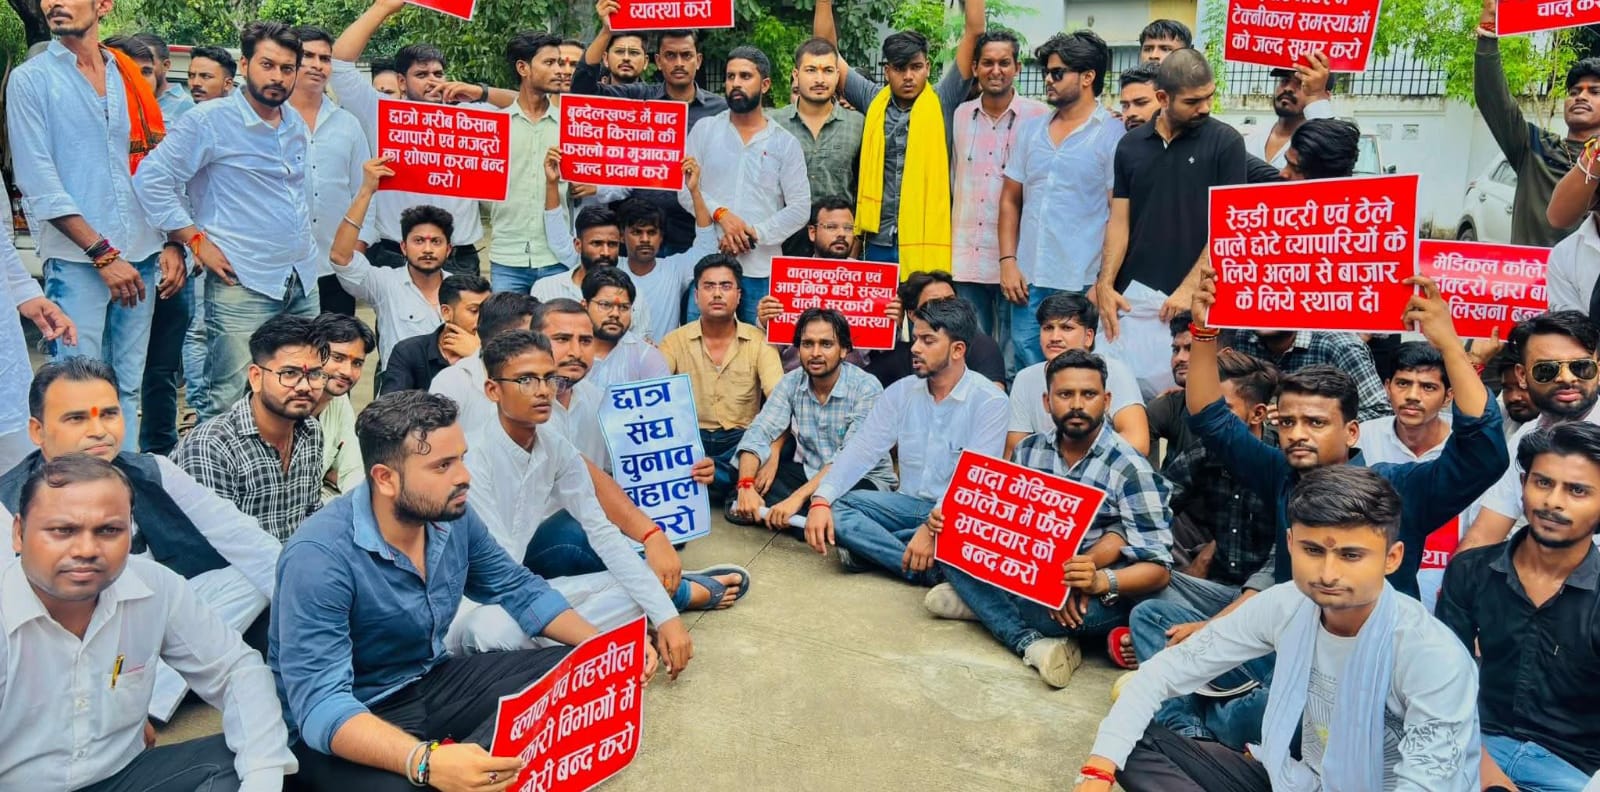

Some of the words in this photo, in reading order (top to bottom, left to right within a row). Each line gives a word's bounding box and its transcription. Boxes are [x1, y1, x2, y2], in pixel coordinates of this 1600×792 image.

[630, 2, 681, 20] व्यवस्था
[1232, 4, 1296, 30] टेक्नीकल
[1297, 10, 1371, 33] समस्याओं
[1232, 30, 1250, 50] को
[1252, 36, 1284, 55] जल्द
[1330, 38, 1362, 59] करो
[389, 107, 418, 125] छात्रो
[422, 110, 453, 129] गरीब
[389, 128, 434, 146] व्यापारी
[439, 130, 454, 148] एवं
[458, 136, 500, 156] मजदूरो
[607, 124, 654, 142] किसानो
[658, 128, 676, 143] की
[382, 148, 400, 162] का
[404, 146, 441, 167] शोषण
[444, 154, 478, 170] करना
[481, 158, 506, 173] बन्द
[562, 142, 603, 158] फसलो
[606, 146, 625, 159] का
[627, 147, 680, 162] मुआवजा
[572, 162, 602, 176] जल्द
[605, 164, 640, 178] प्रदान
[642, 164, 669, 180] करो
[1324, 197, 1350, 225] एवं
[1354, 196, 1394, 224] ठेले
[1214, 232, 1246, 256] वाले
[1250, 230, 1281, 256] छोटे
[1285, 226, 1380, 254] व्यापारियों
[1383, 225, 1408, 252] के
[787, 266, 862, 283] वातानुकूलित
[866, 270, 882, 284] एवं
[1221, 258, 1258, 284] लिये
[1263, 262, 1310, 284] अलग
[1315, 258, 1334, 284] से
[1338, 262, 1400, 284] बाजार
[1433, 252, 1498, 274] मेडिकल
[1502, 258, 1548, 278] कॉले
[774, 280, 828, 297] आधुनिक
[858, 283, 892, 299] संख्या
[1236, 286, 1254, 310] के
[1258, 285, 1296, 311] लिये
[1300, 291, 1354, 312] स्थान
[1491, 281, 1526, 300] द्वारा
[1530, 284, 1547, 302] बा
[792, 296, 821, 309] वाली
[824, 298, 874, 312] सरकारी
[1448, 295, 1508, 320] लिखना
[611, 382, 671, 410] छात्र
[624, 414, 674, 445] संघ
[620, 444, 694, 482] चुनाव
[967, 462, 1008, 491] बांदा
[1008, 474, 1084, 514] मेडिकल
[954, 486, 1018, 522] कॉलेज
[954, 512, 1031, 556] भ्रष्टाचार
[1032, 538, 1056, 563] को
[961, 542, 1001, 572] बन्द
[1000, 556, 1039, 586] करो
[551, 662, 572, 706] एवं
[572, 642, 636, 692] तहसील
[557, 683, 616, 742] विभागों
[619, 676, 636, 712] में
[556, 744, 596, 782] बन्द
[598, 722, 635, 762] करो
